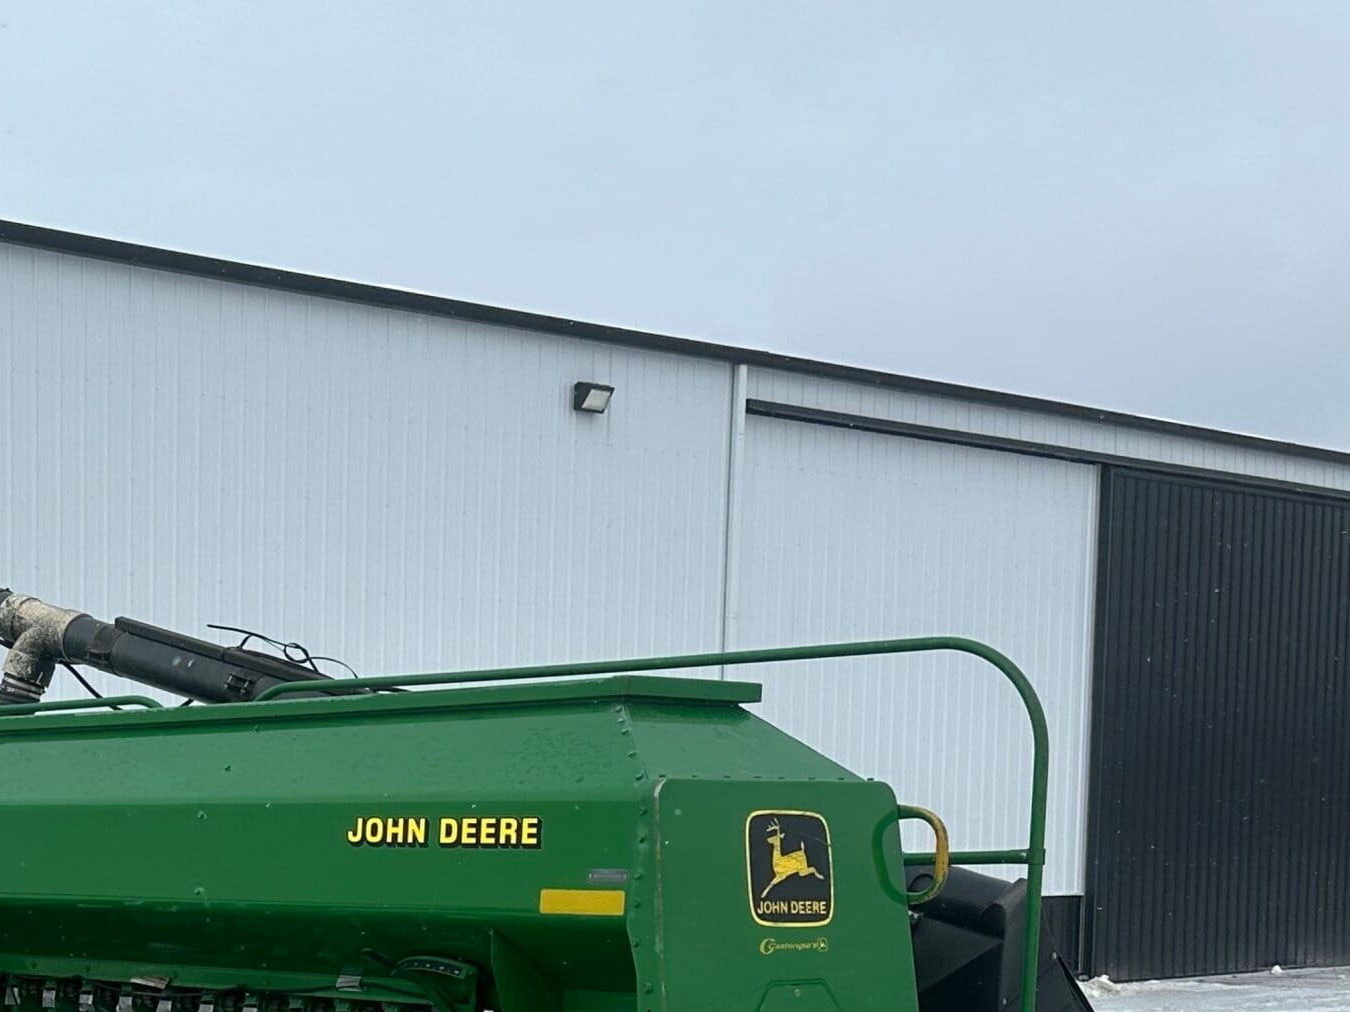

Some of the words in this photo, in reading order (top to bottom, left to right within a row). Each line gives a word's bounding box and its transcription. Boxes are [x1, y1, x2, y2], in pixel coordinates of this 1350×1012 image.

[347, 816, 428, 846] JOHN
[439, 817, 540, 847] DEERE
[757, 901, 788, 914] JOHN
[790, 901, 827, 914] DEERE
